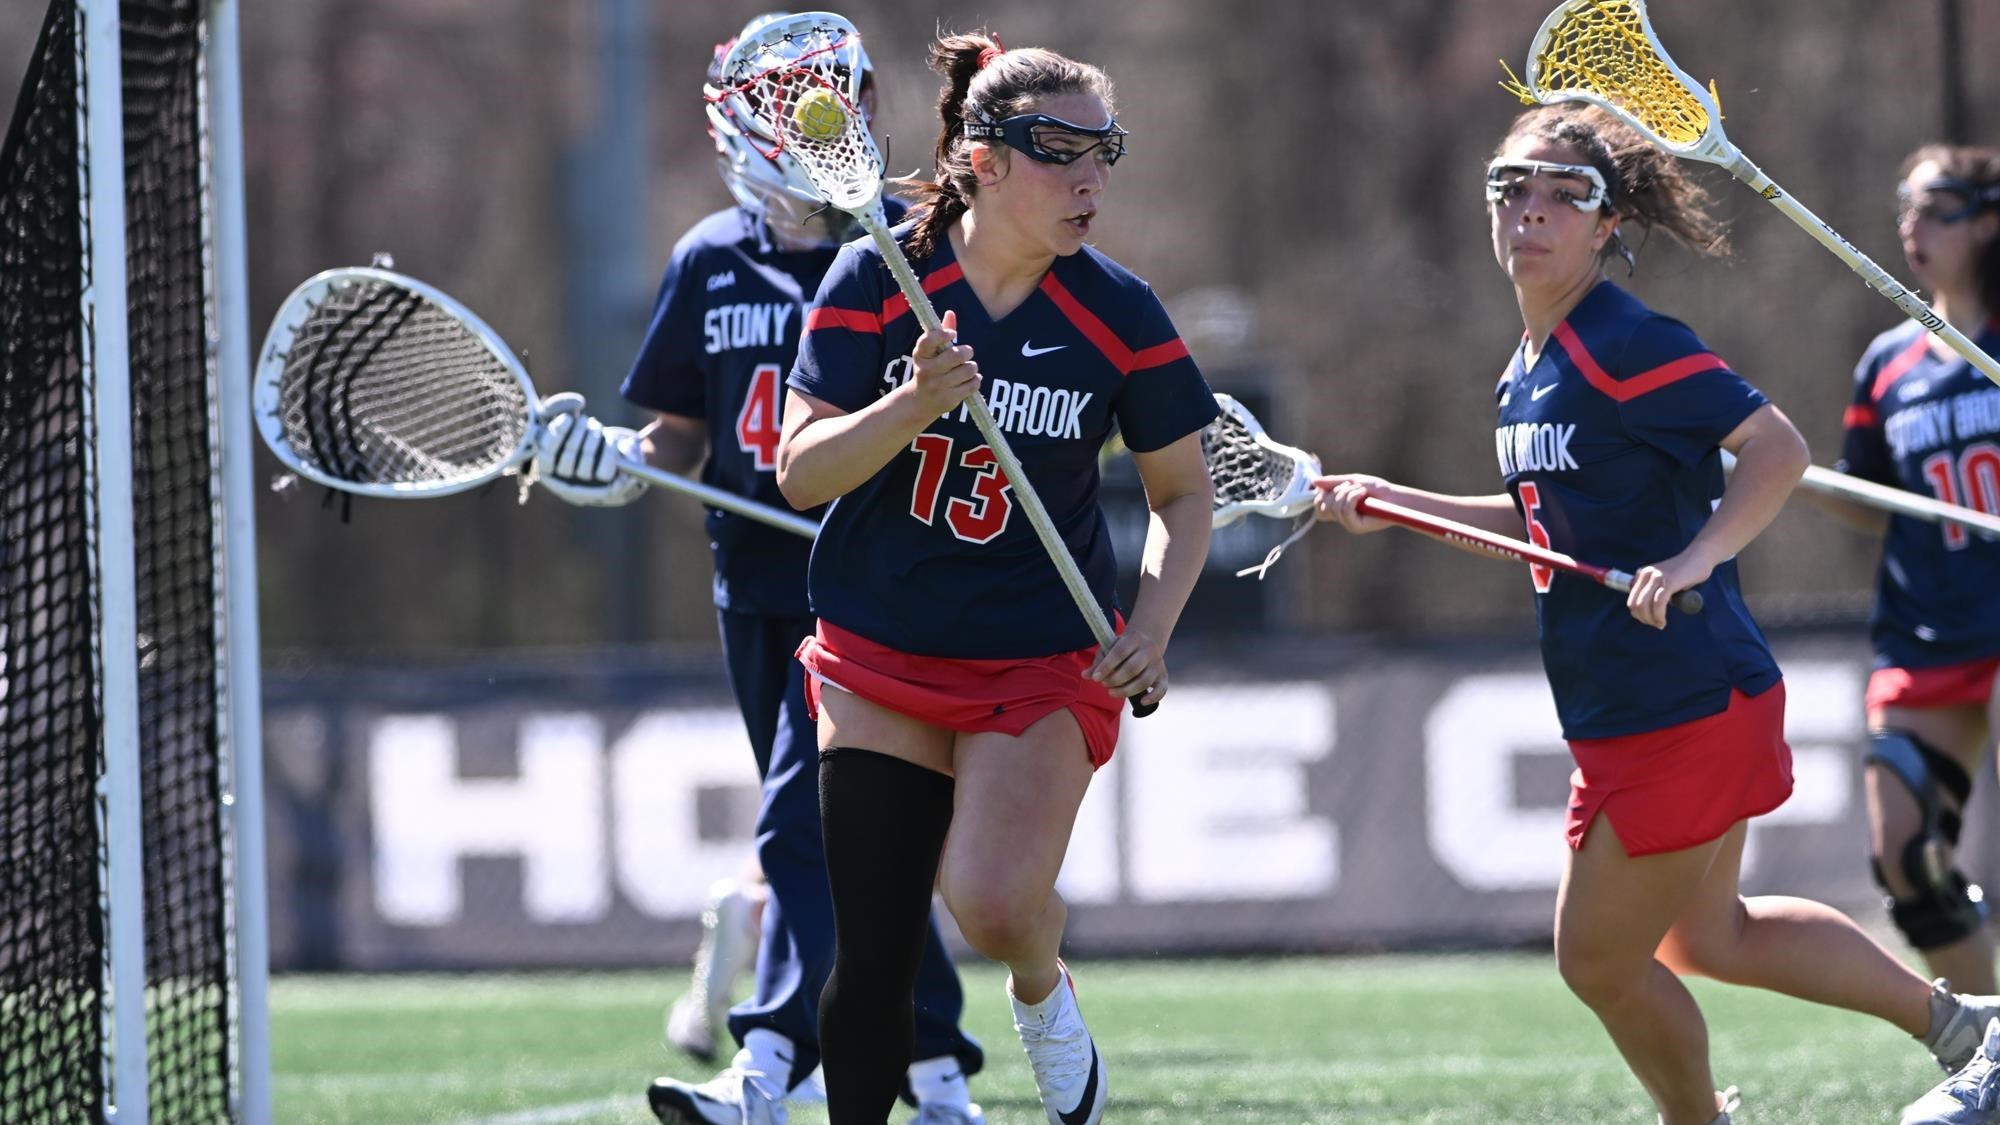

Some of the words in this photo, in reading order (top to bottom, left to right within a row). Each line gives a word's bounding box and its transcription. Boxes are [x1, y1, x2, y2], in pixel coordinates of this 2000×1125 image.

[704, 302, 793, 354] STONY
[735, 363, 782, 472] 4
[988, 378, 1093, 440] BROOK
[909, 433, 1013, 545] 13
[1518, 481, 1554, 593] 5
[1922, 441, 2000, 551] 10
[369, 680, 1341, 925] HOE
